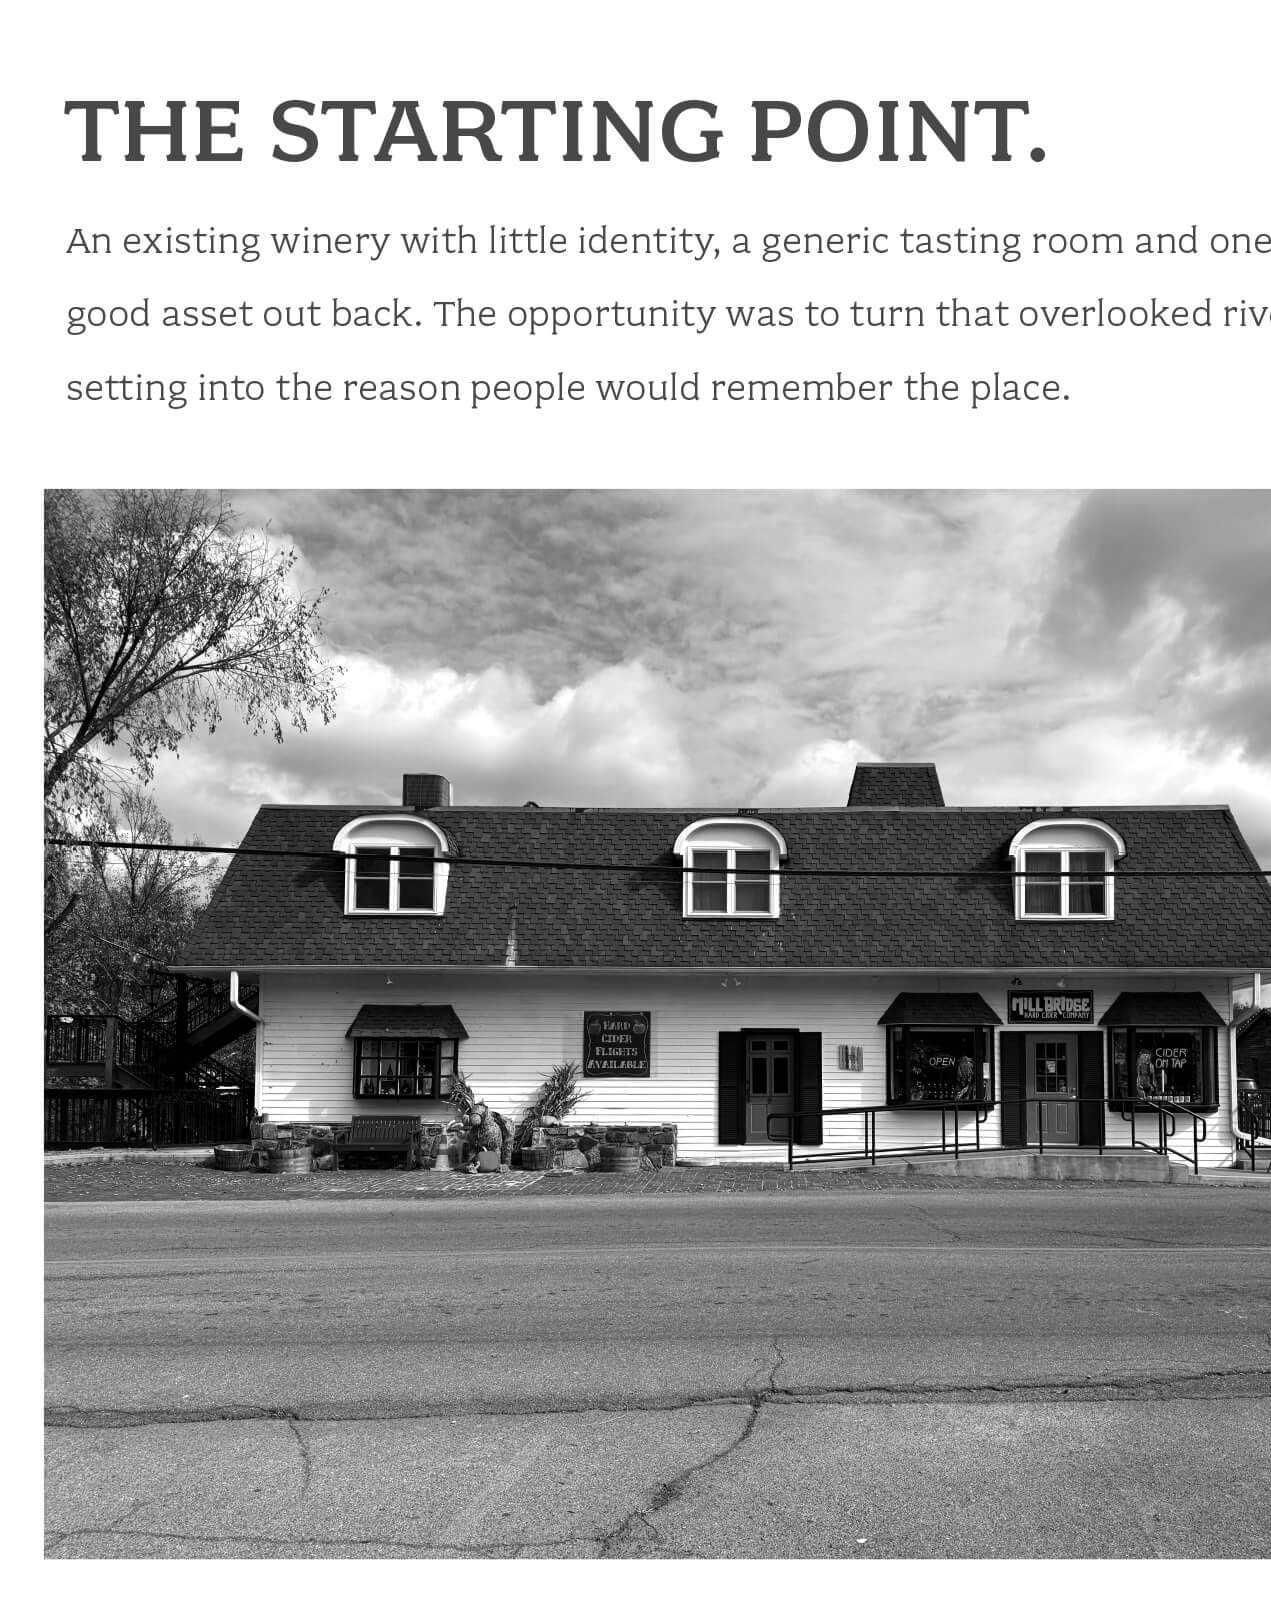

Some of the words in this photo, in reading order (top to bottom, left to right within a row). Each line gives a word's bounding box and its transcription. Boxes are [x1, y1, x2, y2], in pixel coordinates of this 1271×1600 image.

[1012, 997, 1043, 1015] MILL
[1044, 996, 1090, 1014] BRIDGE
[603, 1021, 631, 1030] HARD
[601, 1034, 632, 1043] CIDER
[595, 1047, 638, 1056] FLIGHTS
[1156, 1047, 1187, 1058] CIDER
[588, 1060, 648, 1069] AVAILABLE
[929, 1057, 956, 1066] OPEN
[1156, 1058, 1168, 1068] ON
[1171, 1058, 1187, 1068] TAP
